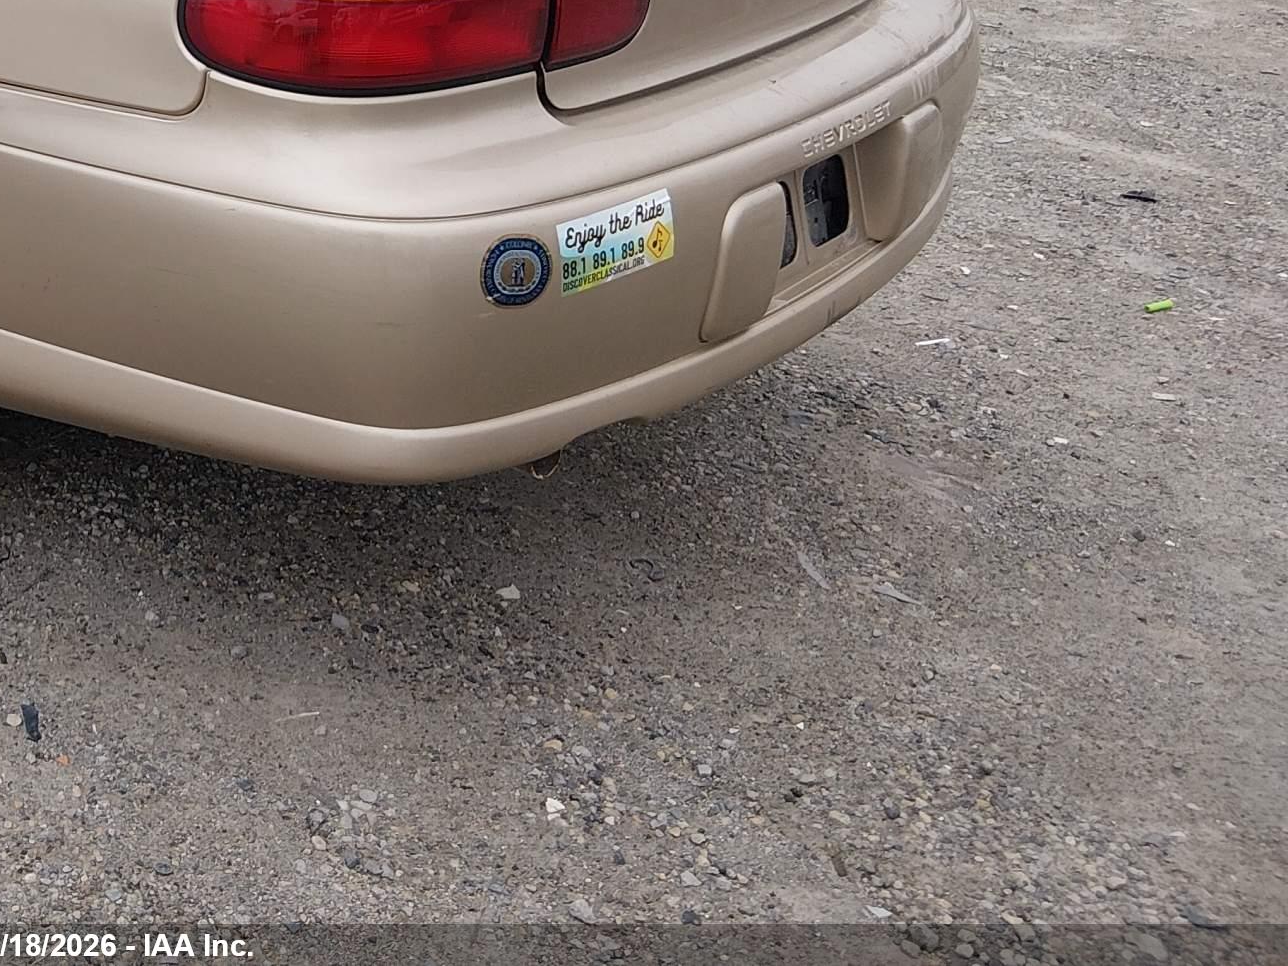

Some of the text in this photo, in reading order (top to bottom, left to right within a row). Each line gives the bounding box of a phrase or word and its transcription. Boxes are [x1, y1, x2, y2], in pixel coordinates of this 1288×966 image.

[801, 100, 890, 158] CHEVROLET
[565, 199, 665, 253] Enjoy the Ride
[562, 257, 586, 280] 88.1
[593, 248, 616, 270] 89.1
[621, 237, 645, 260] 89.9
[562, 254, 645, 293] DISCOVERCLASSICAL.ORG
